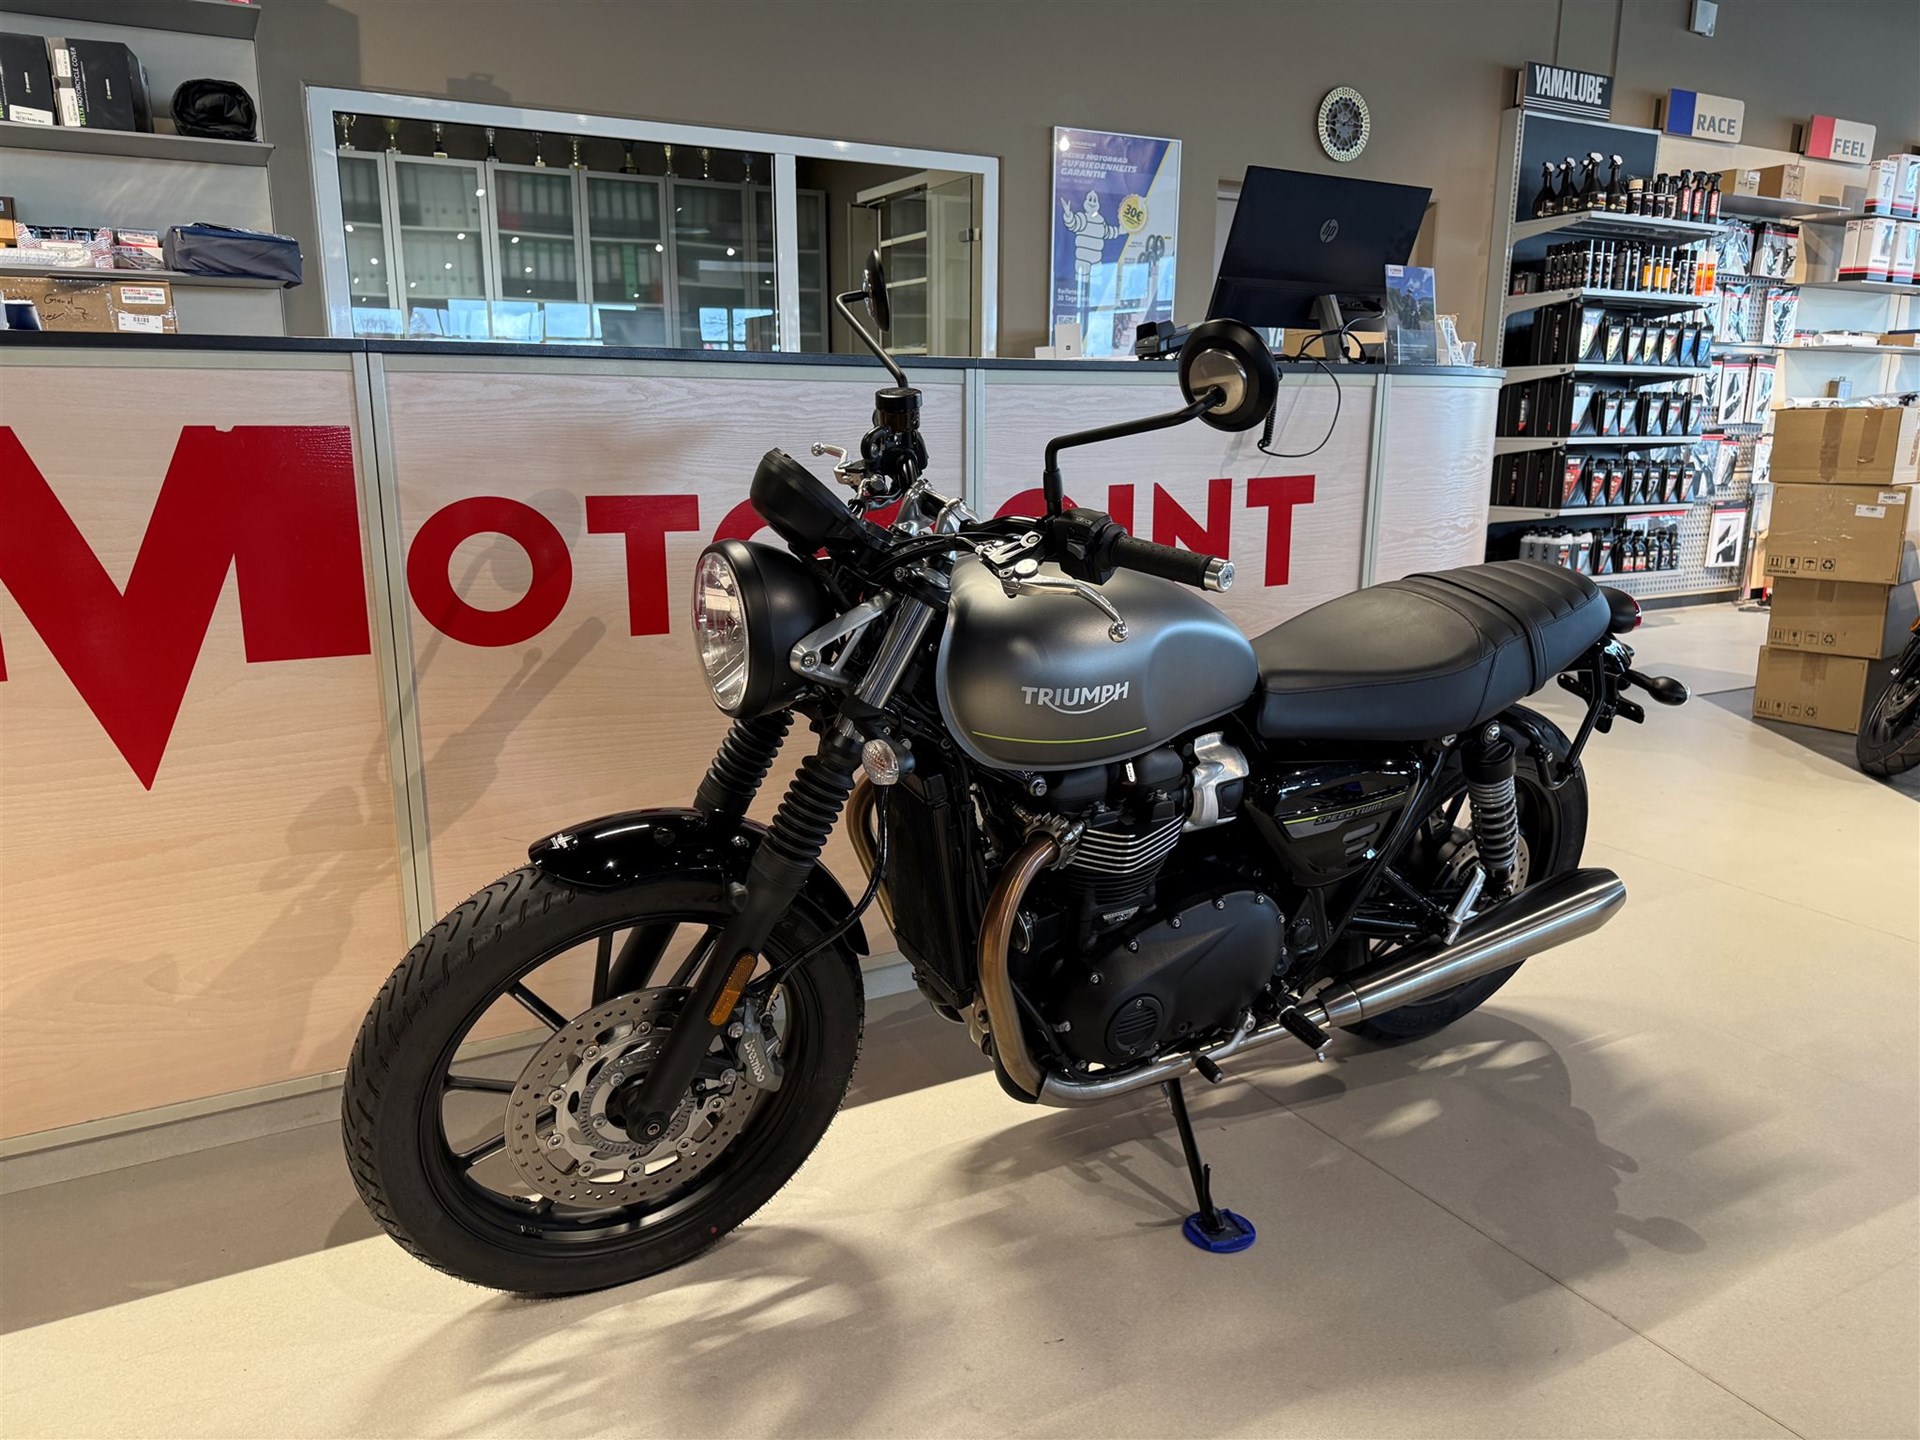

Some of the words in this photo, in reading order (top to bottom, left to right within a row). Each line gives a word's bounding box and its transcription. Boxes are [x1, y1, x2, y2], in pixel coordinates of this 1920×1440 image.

[70, 46, 79, 67] COVER
[73, 67, 83, 107] MOTORCYCLE
[79, 107, 87, 125] DELTA
[1697, 114, 1737, 136] RACE
[1834, 138, 1867, 158] FEEL
[1061, 159, 1138, 173] ZUFRIEDENHEITS
[1085, 154, 1129, 164] MOTORRAD
[1060, 168, 1107, 179] GARANTIE
[1124, 204, 1143, 222] 30€
[1021, 681, 1130, 715] TRIUMPH
[744, 1038, 765, 1082] brembo
